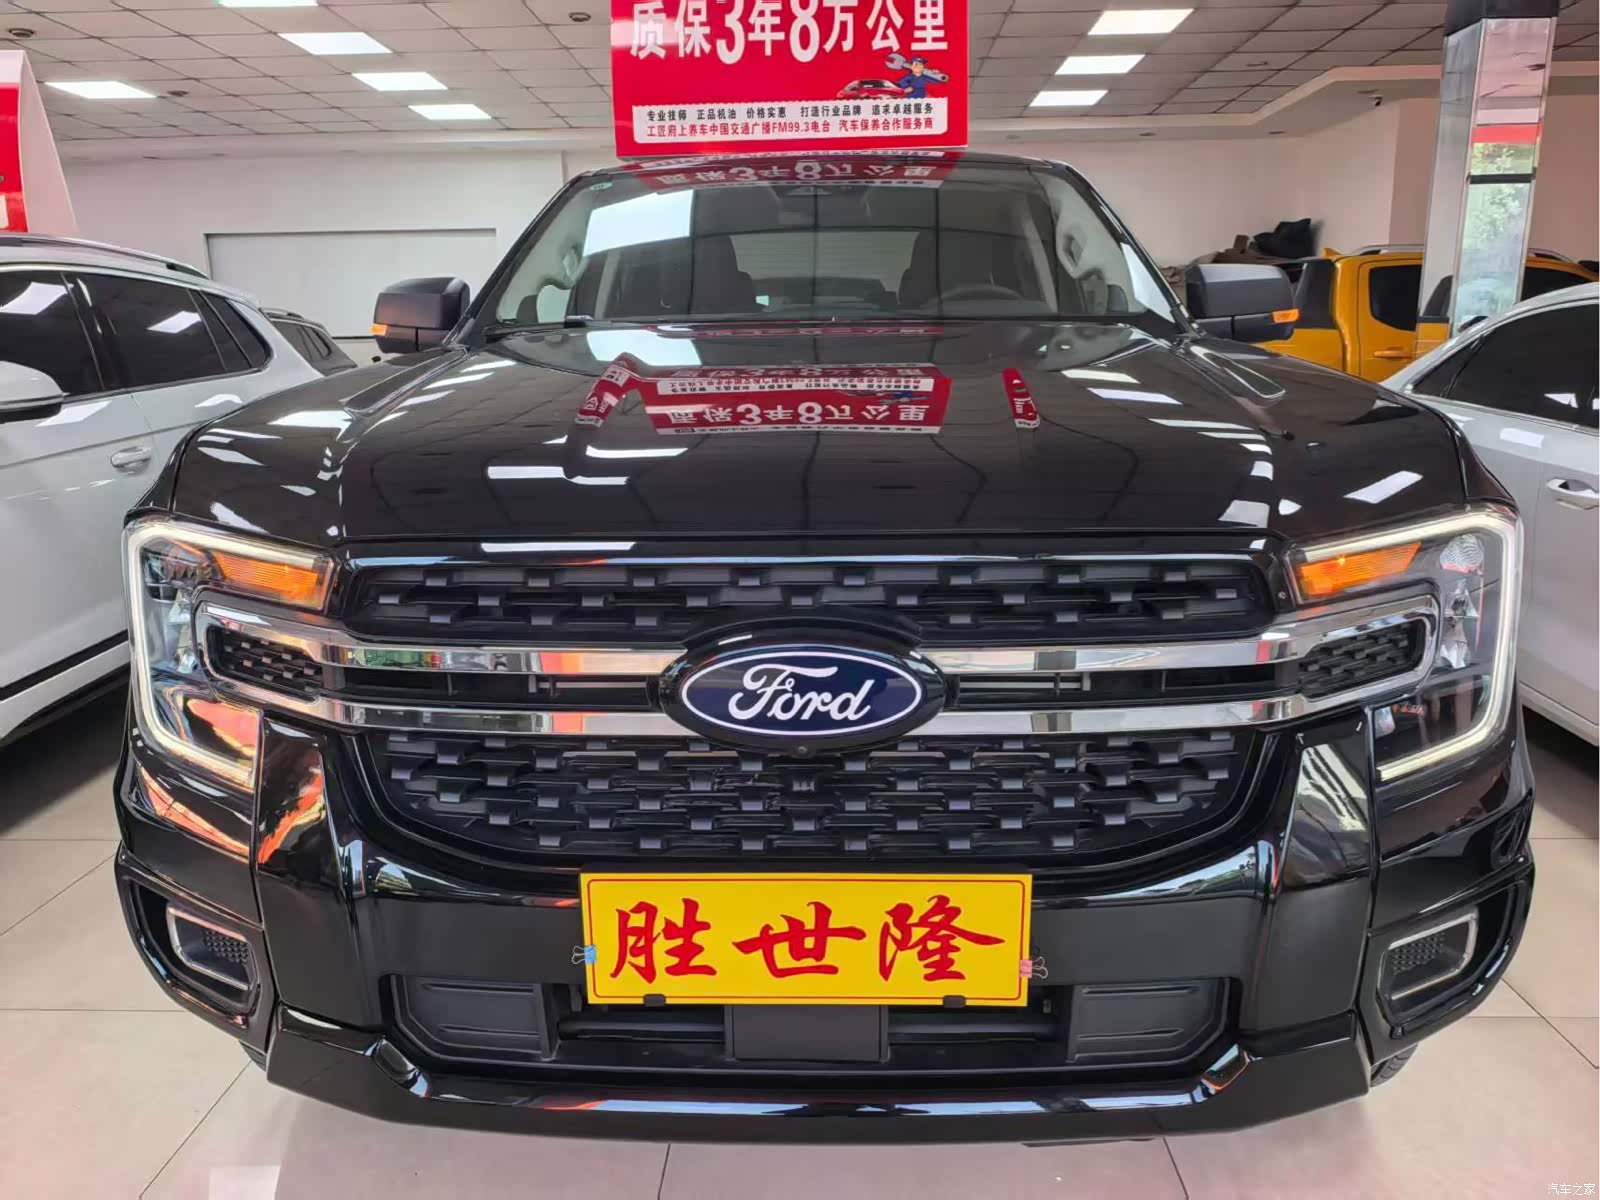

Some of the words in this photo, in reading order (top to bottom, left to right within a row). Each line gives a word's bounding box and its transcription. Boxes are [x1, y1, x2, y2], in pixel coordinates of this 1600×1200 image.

[630, 0, 949, 65] 质保3年8万公里
[647, 109, 688, 121] 专业技师
[697, 108, 737, 120] 正品机油
[746, 106, 787, 119] 价格实惠
[800, 105, 862, 117] 打造行业品牌
[872, 103, 933, 116] 追求卓越服务
[839, 117, 934, 132] 汽车保养合作服务商
[728, 663, 875, 721] Ford
[609, 894, 1006, 985] 胜世隆
